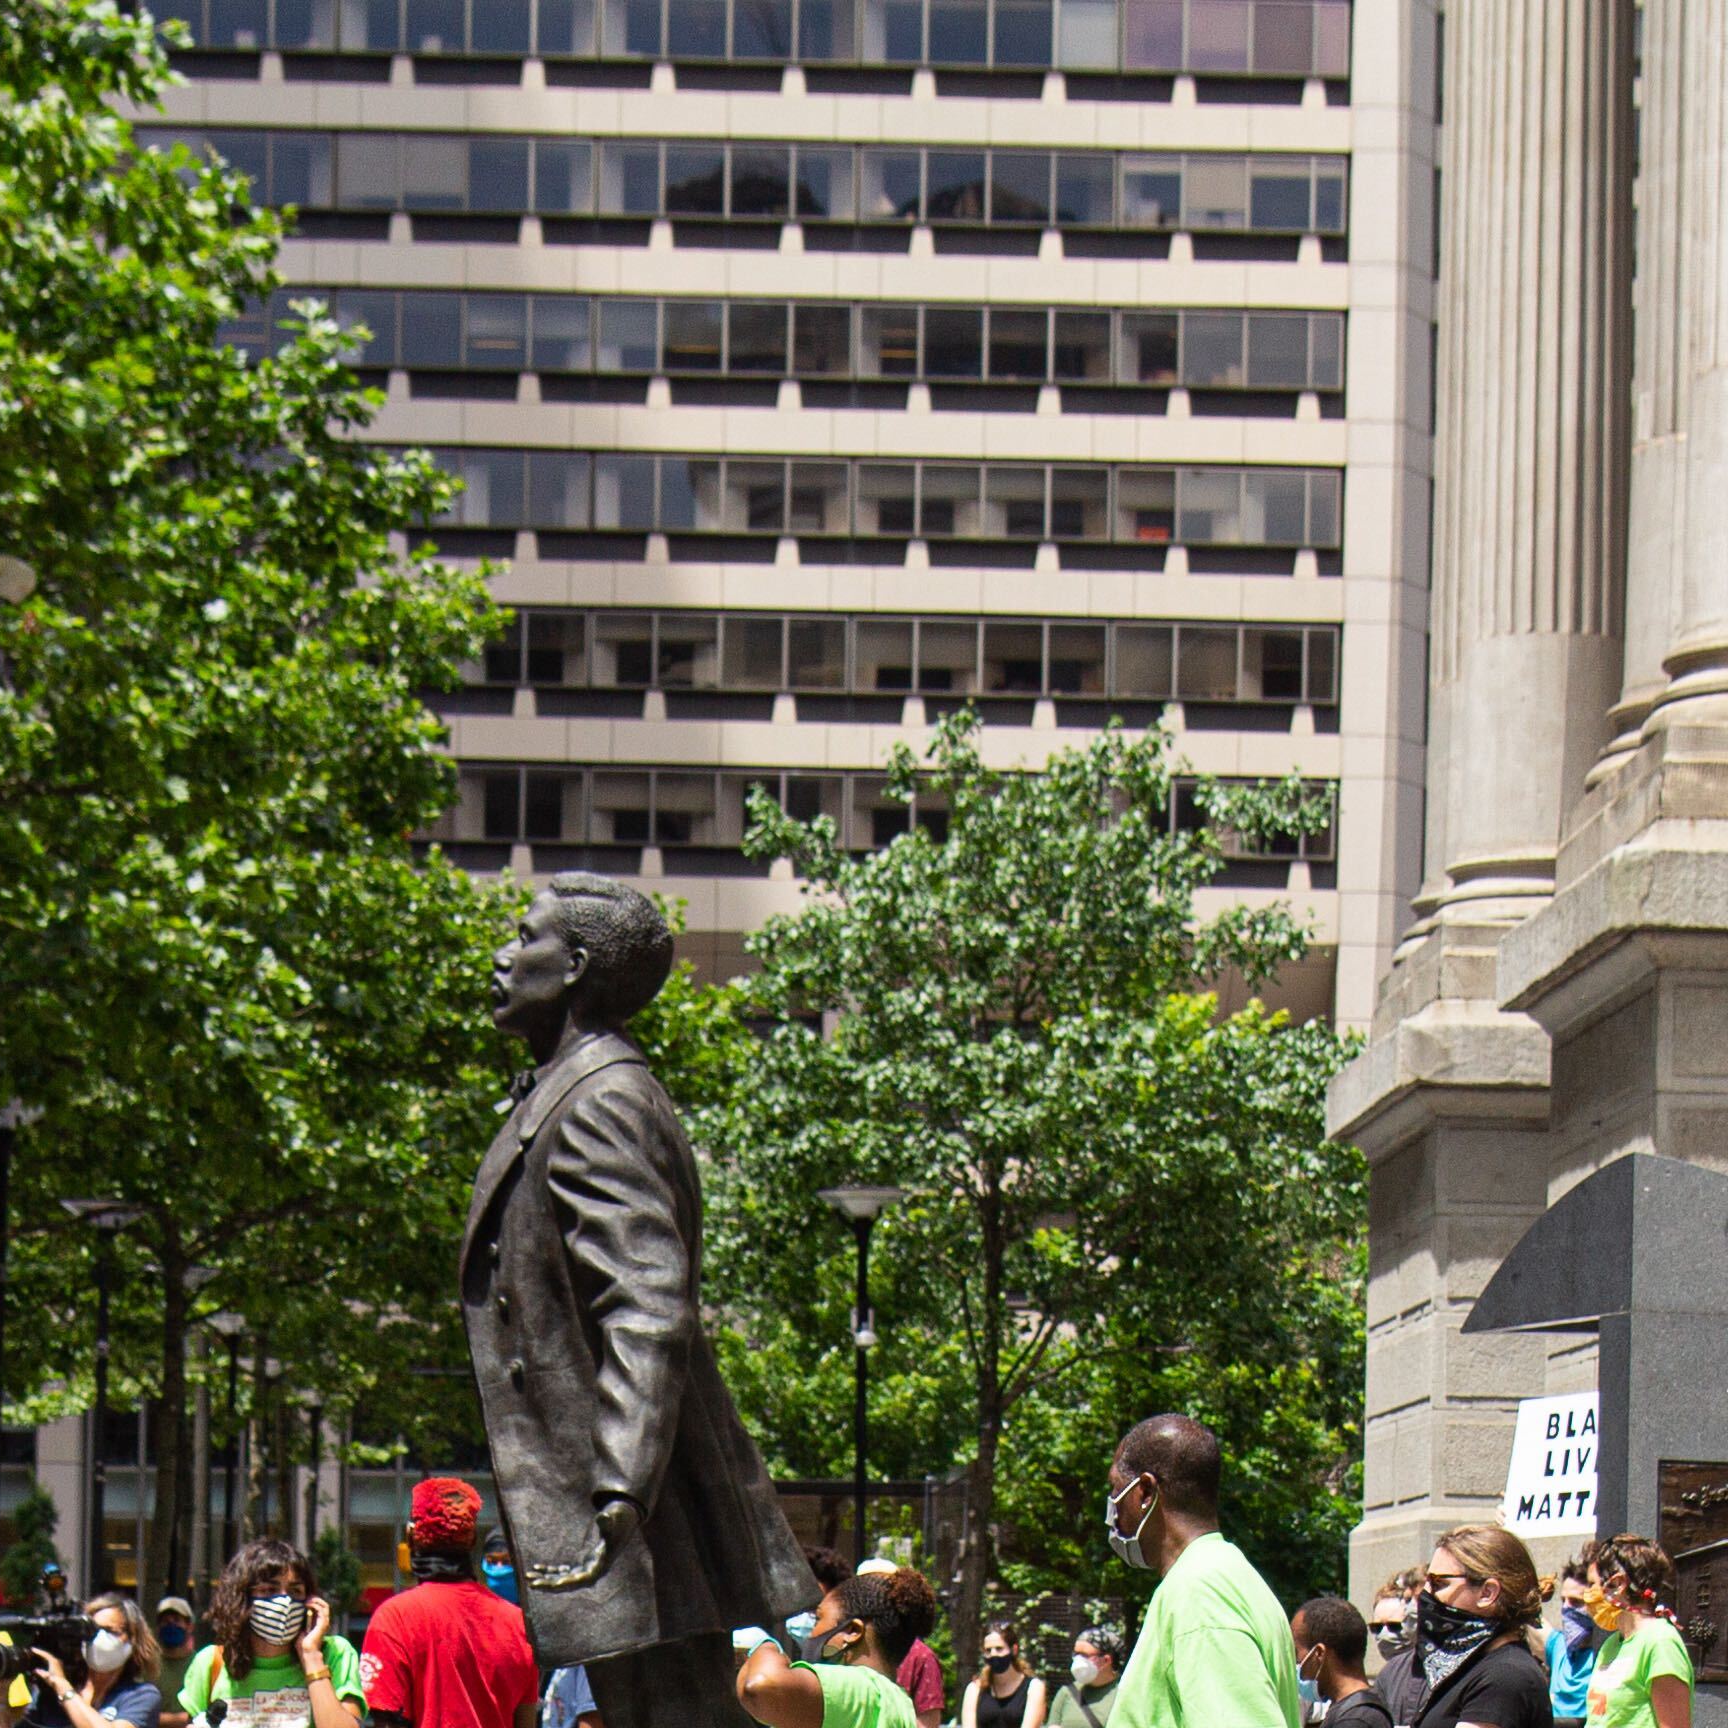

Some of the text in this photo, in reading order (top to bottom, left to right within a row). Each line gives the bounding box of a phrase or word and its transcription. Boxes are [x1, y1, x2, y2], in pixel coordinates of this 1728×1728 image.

[1546, 1408, 1596, 1440] BLA
[1544, 1447, 1600, 1477] LIV
[1517, 1490, 1599, 1521] MATT
